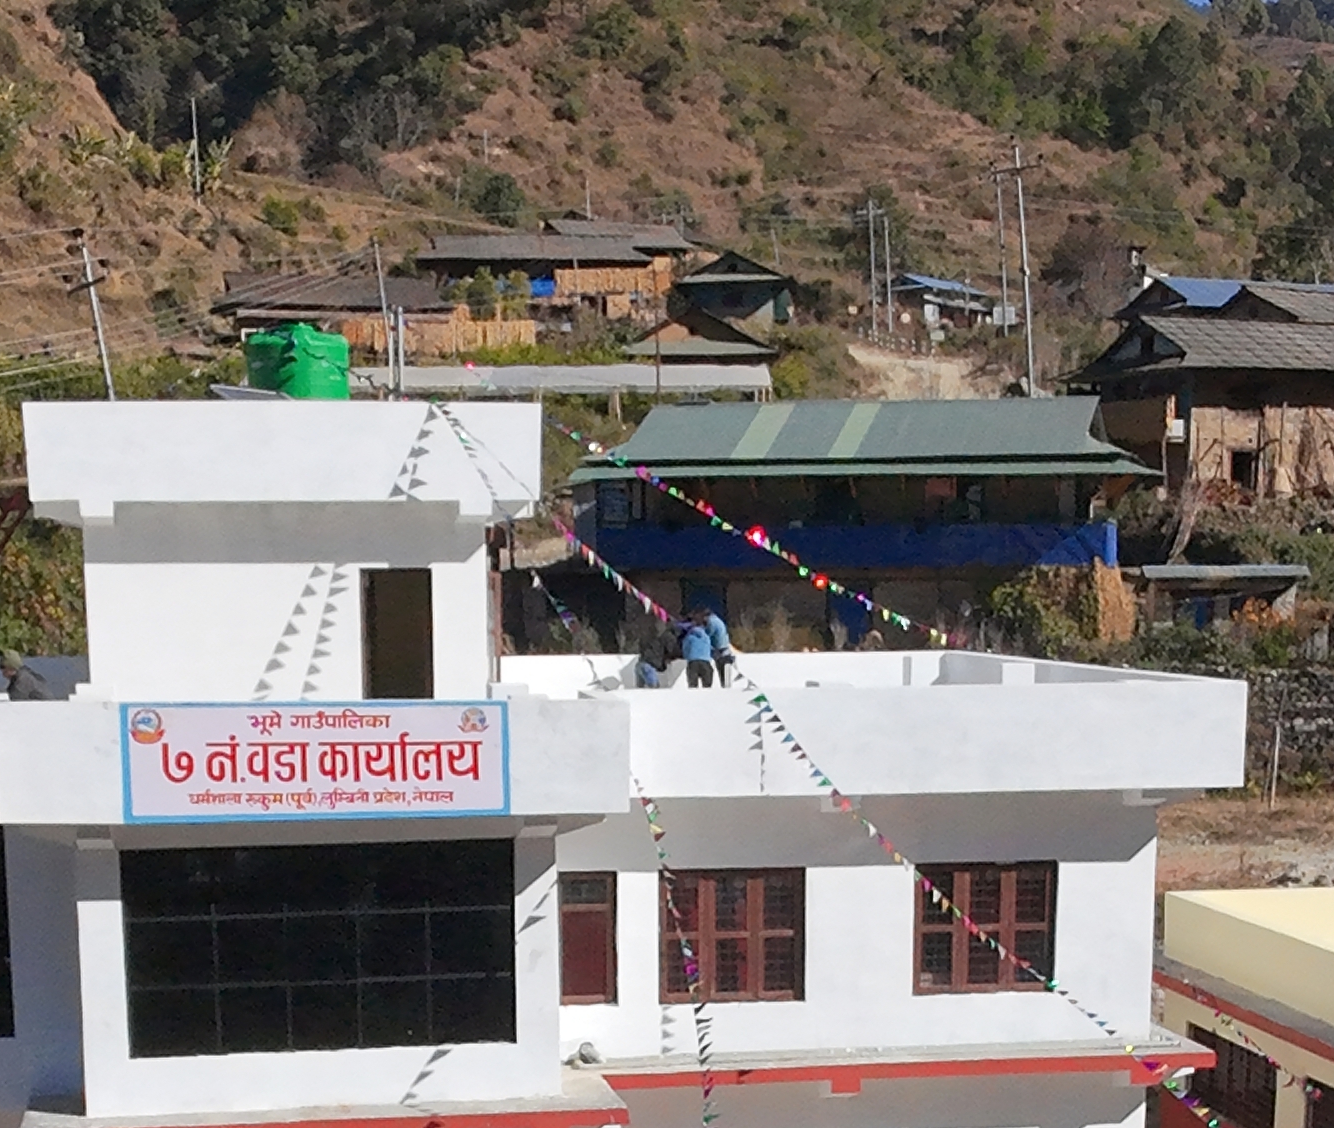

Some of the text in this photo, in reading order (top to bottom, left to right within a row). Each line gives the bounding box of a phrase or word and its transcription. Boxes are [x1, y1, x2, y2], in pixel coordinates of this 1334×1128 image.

[247, 708, 391, 736] भूमे गाउँपालिका
[161, 742, 195, 783] ७
[318, 731, 483, 782] कार्यालय
